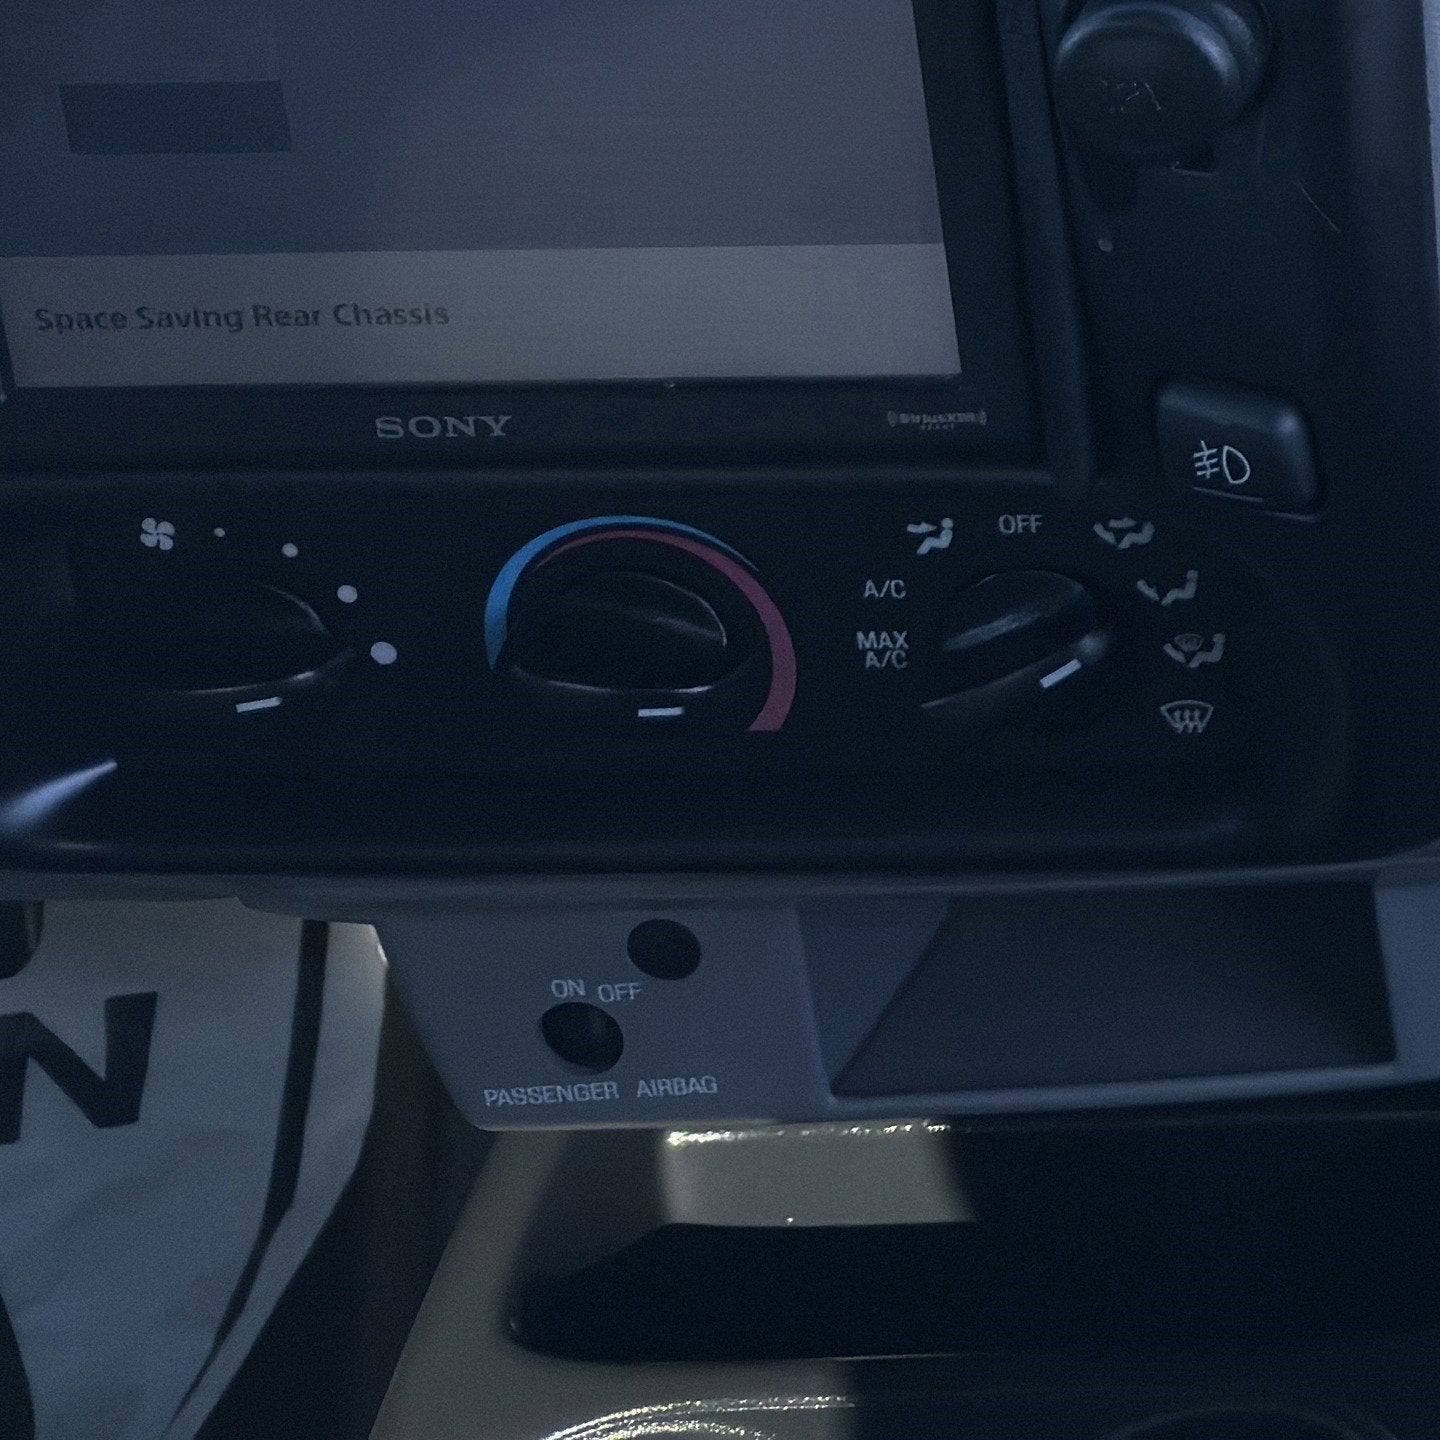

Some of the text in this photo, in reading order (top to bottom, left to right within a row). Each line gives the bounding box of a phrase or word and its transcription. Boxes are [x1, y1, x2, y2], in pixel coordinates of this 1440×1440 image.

[34, 302, 449, 334] Space Saving Rear Chassis
[376, 416, 512, 440] SONY
[999, 516, 1042, 534] OFF
[864, 580, 907, 599] A/C
[856, 631, 908, 650] MAX
[864, 650, 908, 670] A/C
[551, 979, 585, 998] ON
[598, 982, 641, 1003] OFF
[484, 1077, 718, 1108] PASSENGER AIRBAG
